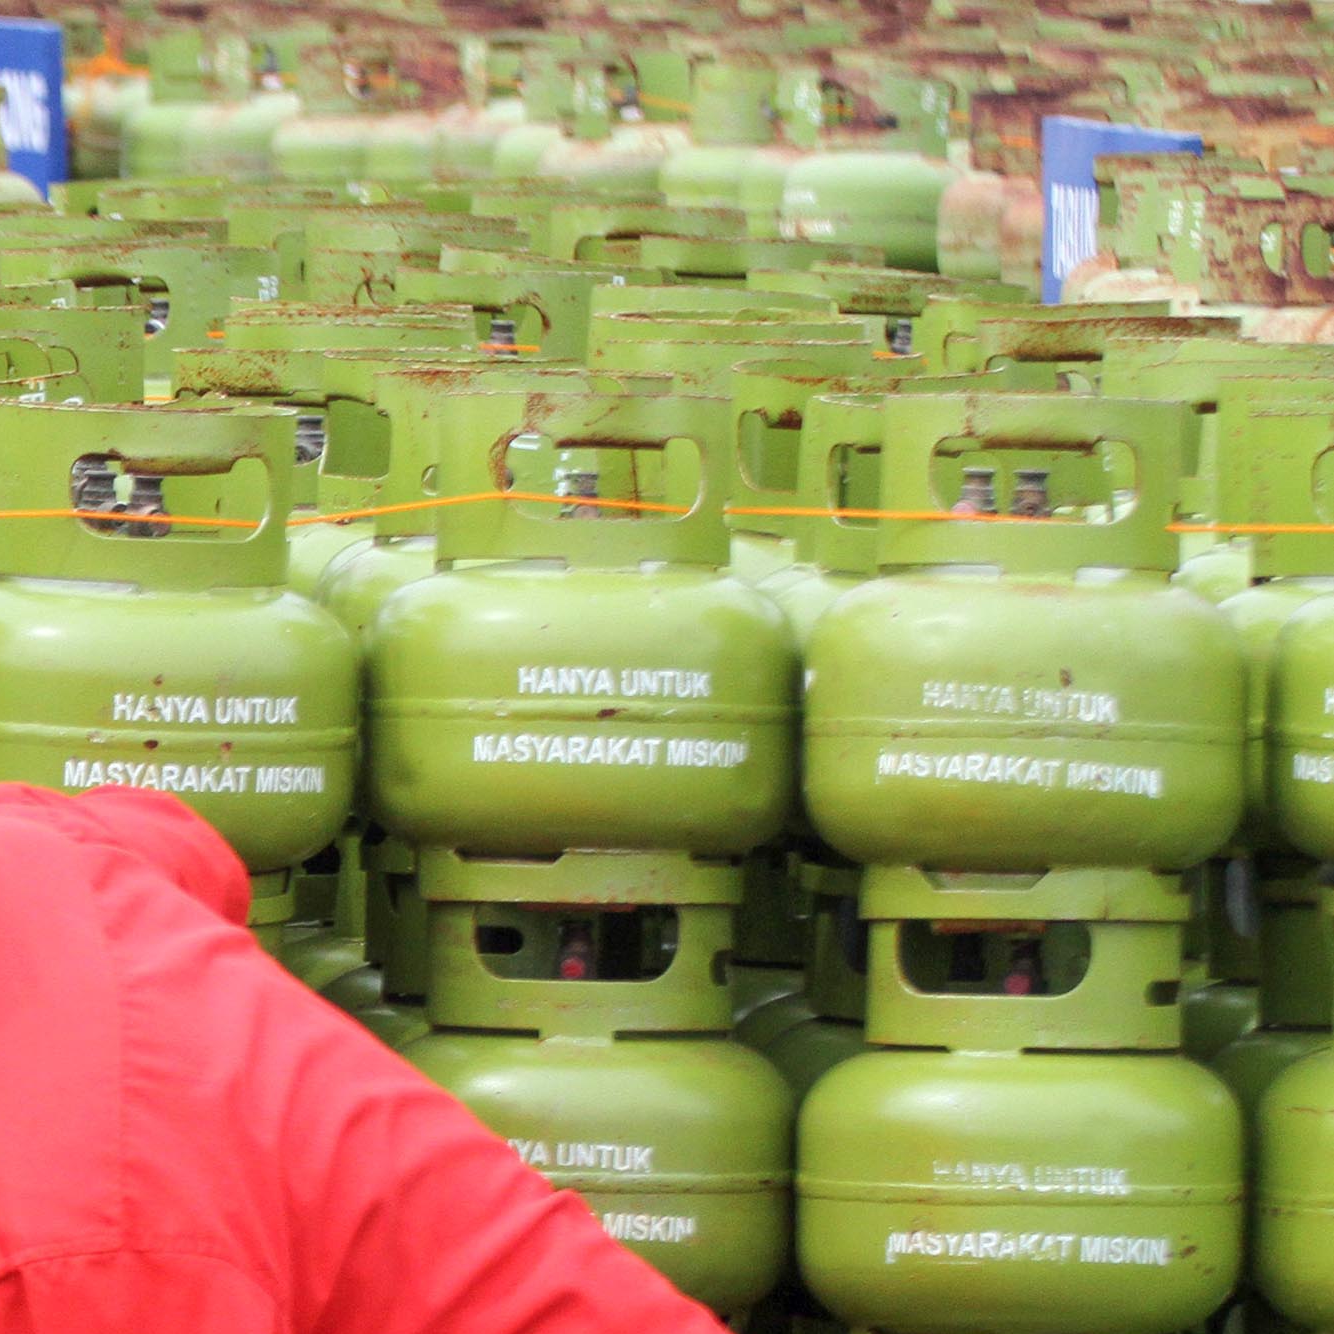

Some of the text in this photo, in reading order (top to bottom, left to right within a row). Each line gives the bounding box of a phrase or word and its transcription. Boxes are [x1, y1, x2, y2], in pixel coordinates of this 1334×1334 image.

[518, 666, 709, 698] HANYA UNTUK
[113, 693, 297, 725] HANYA UNTUK
[473, 733, 748, 768] MASYARAKAT MISKIN
[63, 759, 323, 794] MASYARAKAT MISKIN
[877, 751, 1162, 798] MASYARAKAT MISKIN
[556, 1143, 652, 1175] UNTUK
[602, 1213, 695, 1243] MISKIN
[885, 1229, 1168, 1266] MASYARAKAT MISKIN
